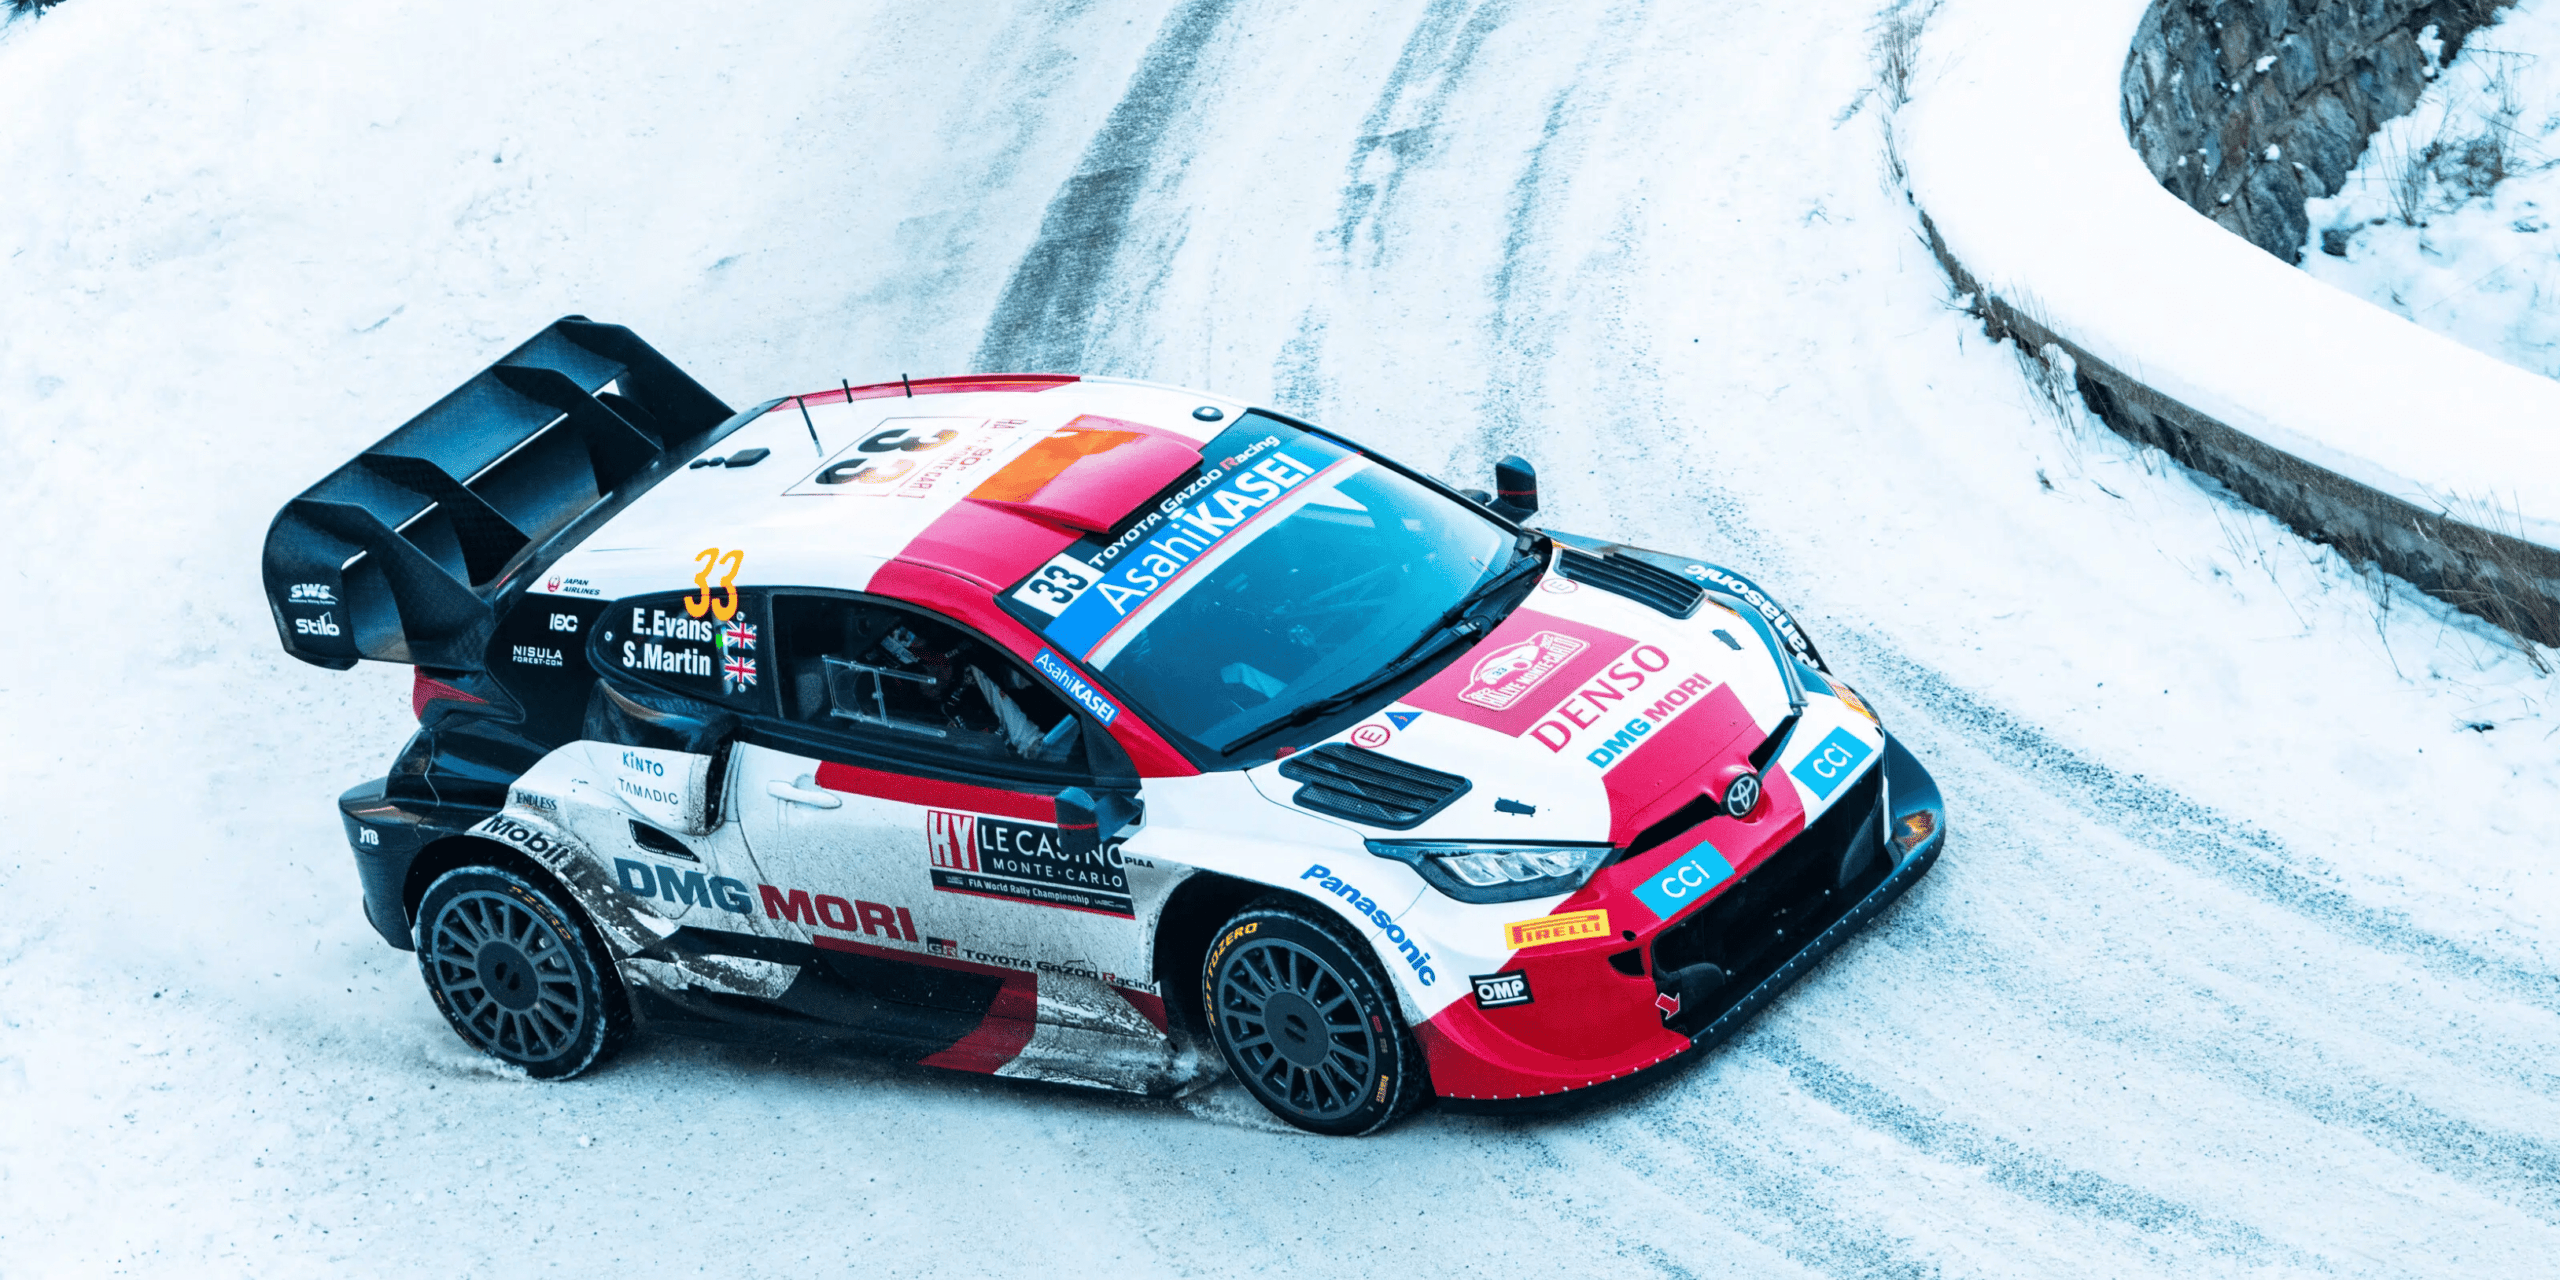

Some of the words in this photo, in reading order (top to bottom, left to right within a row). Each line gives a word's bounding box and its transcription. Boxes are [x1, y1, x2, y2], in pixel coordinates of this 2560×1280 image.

[815, 428, 959, 485] 33
[1088, 513, 1163, 568] TOYOTA
[1159, 468, 1224, 514] GAZOO
[1219, 435, 1281, 471] Racing
[1096, 451, 1315, 616] AsahiKASEI
[291, 583, 334, 600] SWS
[562, 586, 601, 595] AIRLINES
[563, 577, 589, 586] JAPAN
[683, 547, 744, 621] 33
[1028, 565, 1089, 604] 33
[295, 611, 340, 636] Stilo
[632, 607, 713, 642] E.Evans
[1684, 565, 1820, 669] Panasonic
[513, 645, 563, 660] NISULA
[622, 640, 711, 676] S.Martin
[1036, 653, 1115, 723] AsahiKASEI
[1529, 644, 1670, 753] DENSO
[1586, 718, 1652, 769] DMG
[1643, 672, 1712, 723] MORI
[516, 792, 557, 811] ENDLESS
[481, 813, 570, 865] Mobil
[929, 811, 973, 870] HY
[981, 825, 1010, 852] LE
[1125, 856, 1154, 869] PIAA
[613, 857, 753, 915] DMG
[758, 884, 919, 942] MORI
[968, 878, 983, 889] FIA
[984, 881, 1008, 892] World
[1010, 884, 1030, 896] Rally
[1032, 887, 1090, 905] Championship
[1300, 864, 1436, 987] Panasonic
[1511, 913, 1601, 944] PIRELLI
[963, 949, 1032, 968] TOYOTA
[1036, 961, 1099, 980] GAZOO
[1101, 972, 1157, 994] Racing
[1477, 980, 1524, 1001] OMP
